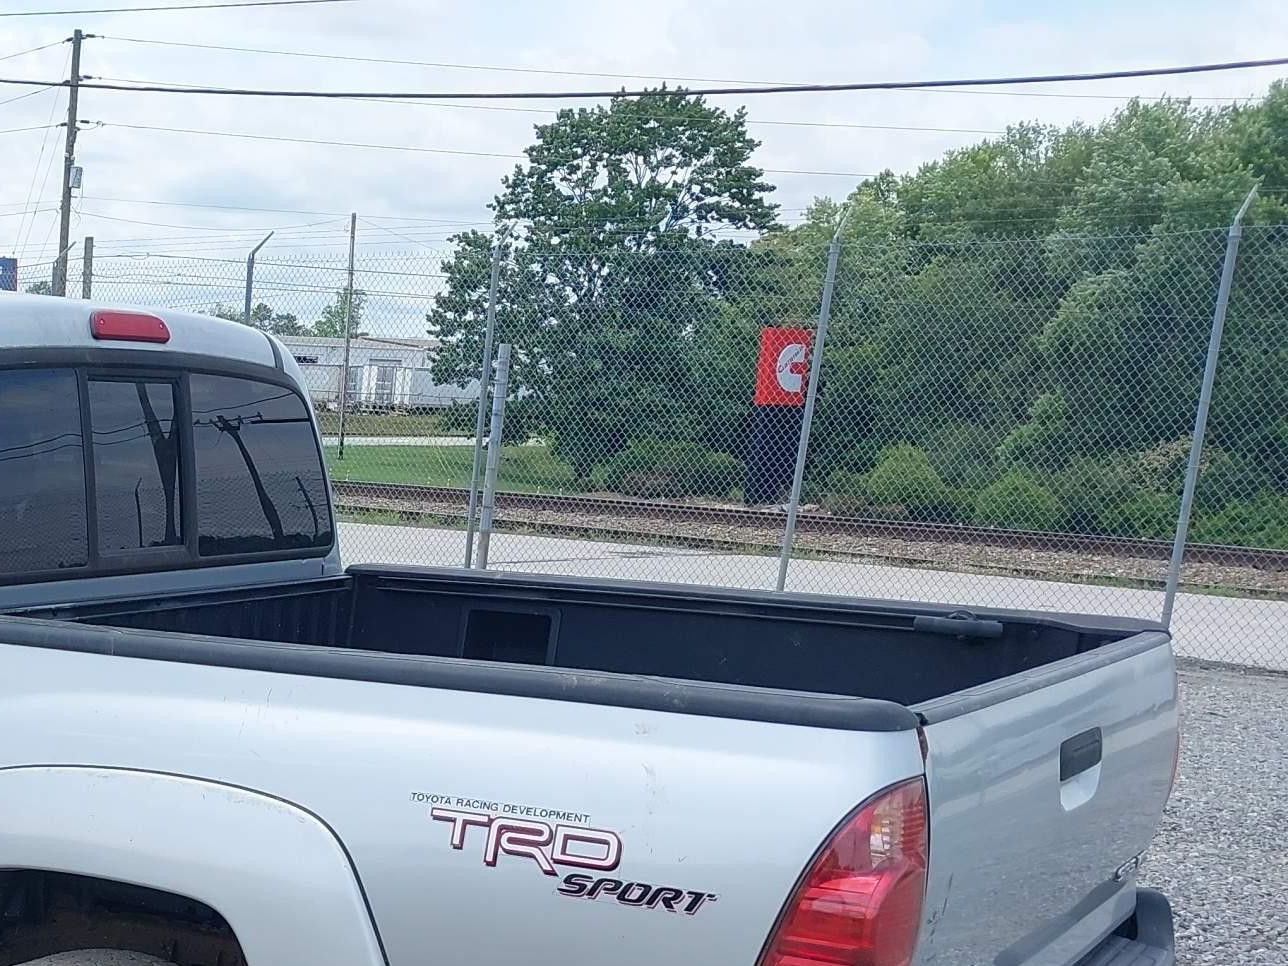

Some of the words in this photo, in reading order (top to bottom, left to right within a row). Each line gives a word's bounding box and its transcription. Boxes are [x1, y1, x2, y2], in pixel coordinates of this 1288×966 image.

[410, 792, 453, 806] TOYOTA
[455, 797, 500, 813] RACING
[502, 803, 592, 824] DEVELOPMENT
[430, 806, 623, 876] TRD
[556, 872, 719, 916] SPORT
